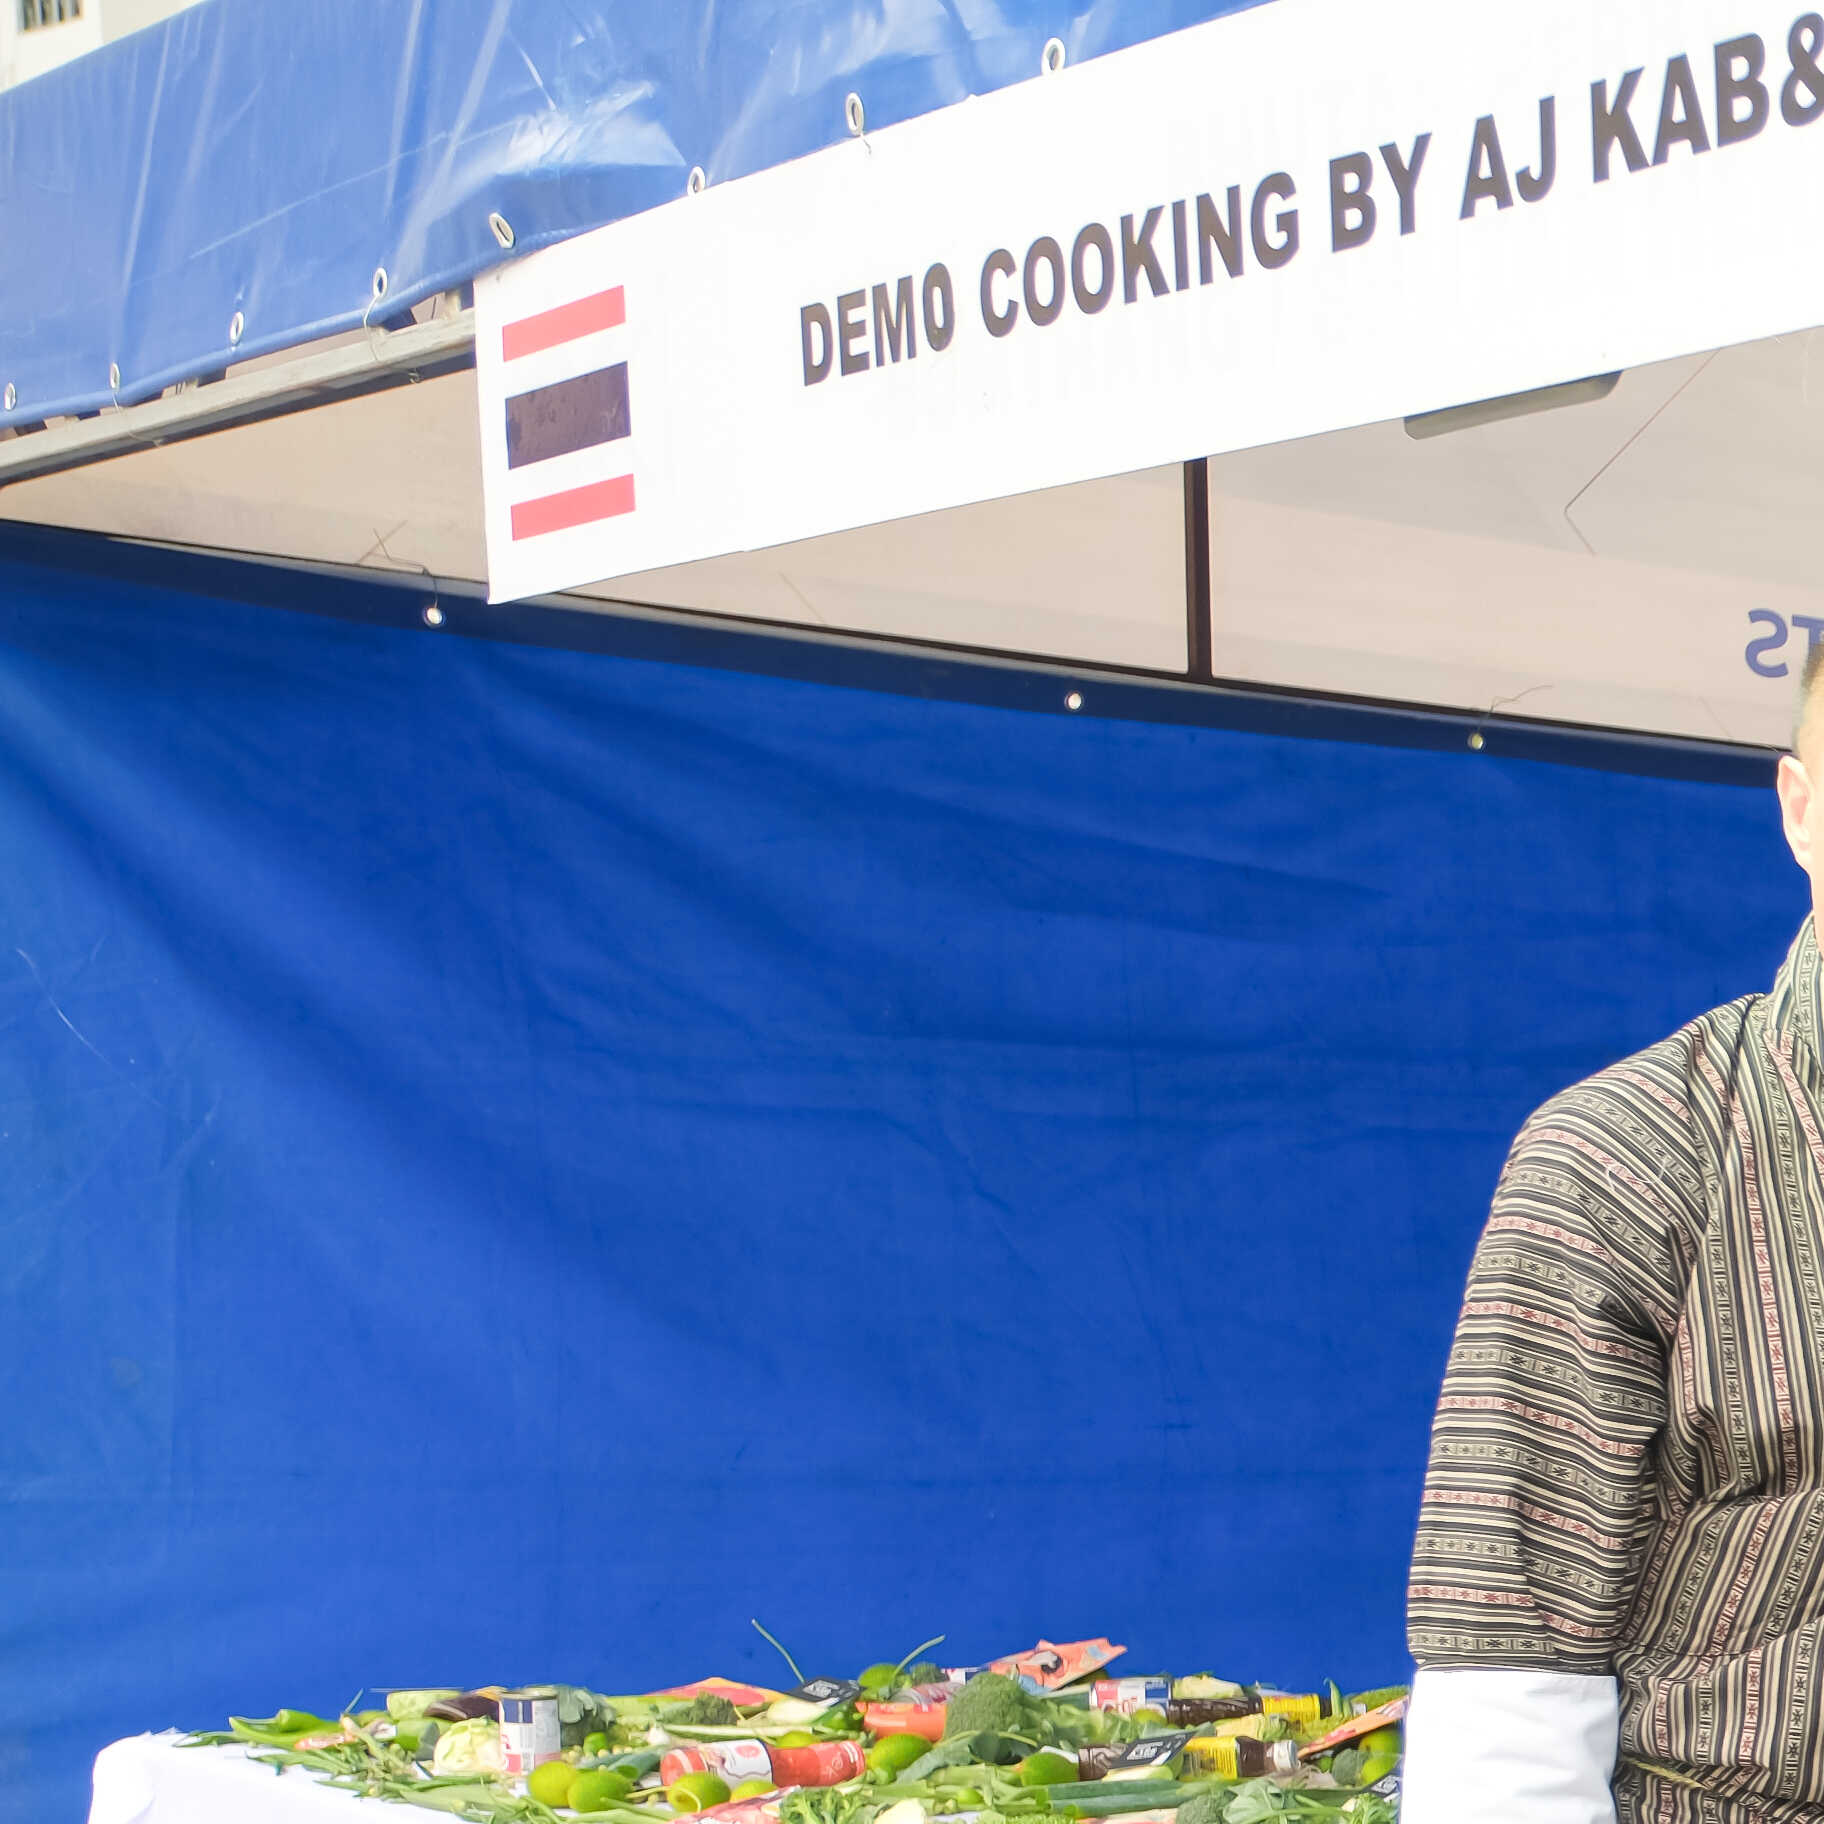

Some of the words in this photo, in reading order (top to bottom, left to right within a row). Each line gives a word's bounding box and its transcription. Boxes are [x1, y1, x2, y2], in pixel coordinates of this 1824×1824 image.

[800, 263, 955, 387] DEMO
[979, 171, 1300, 338] COOKING
[1328, 132, 1432, 253] BY
[1460, 95, 1556, 220] AJ
